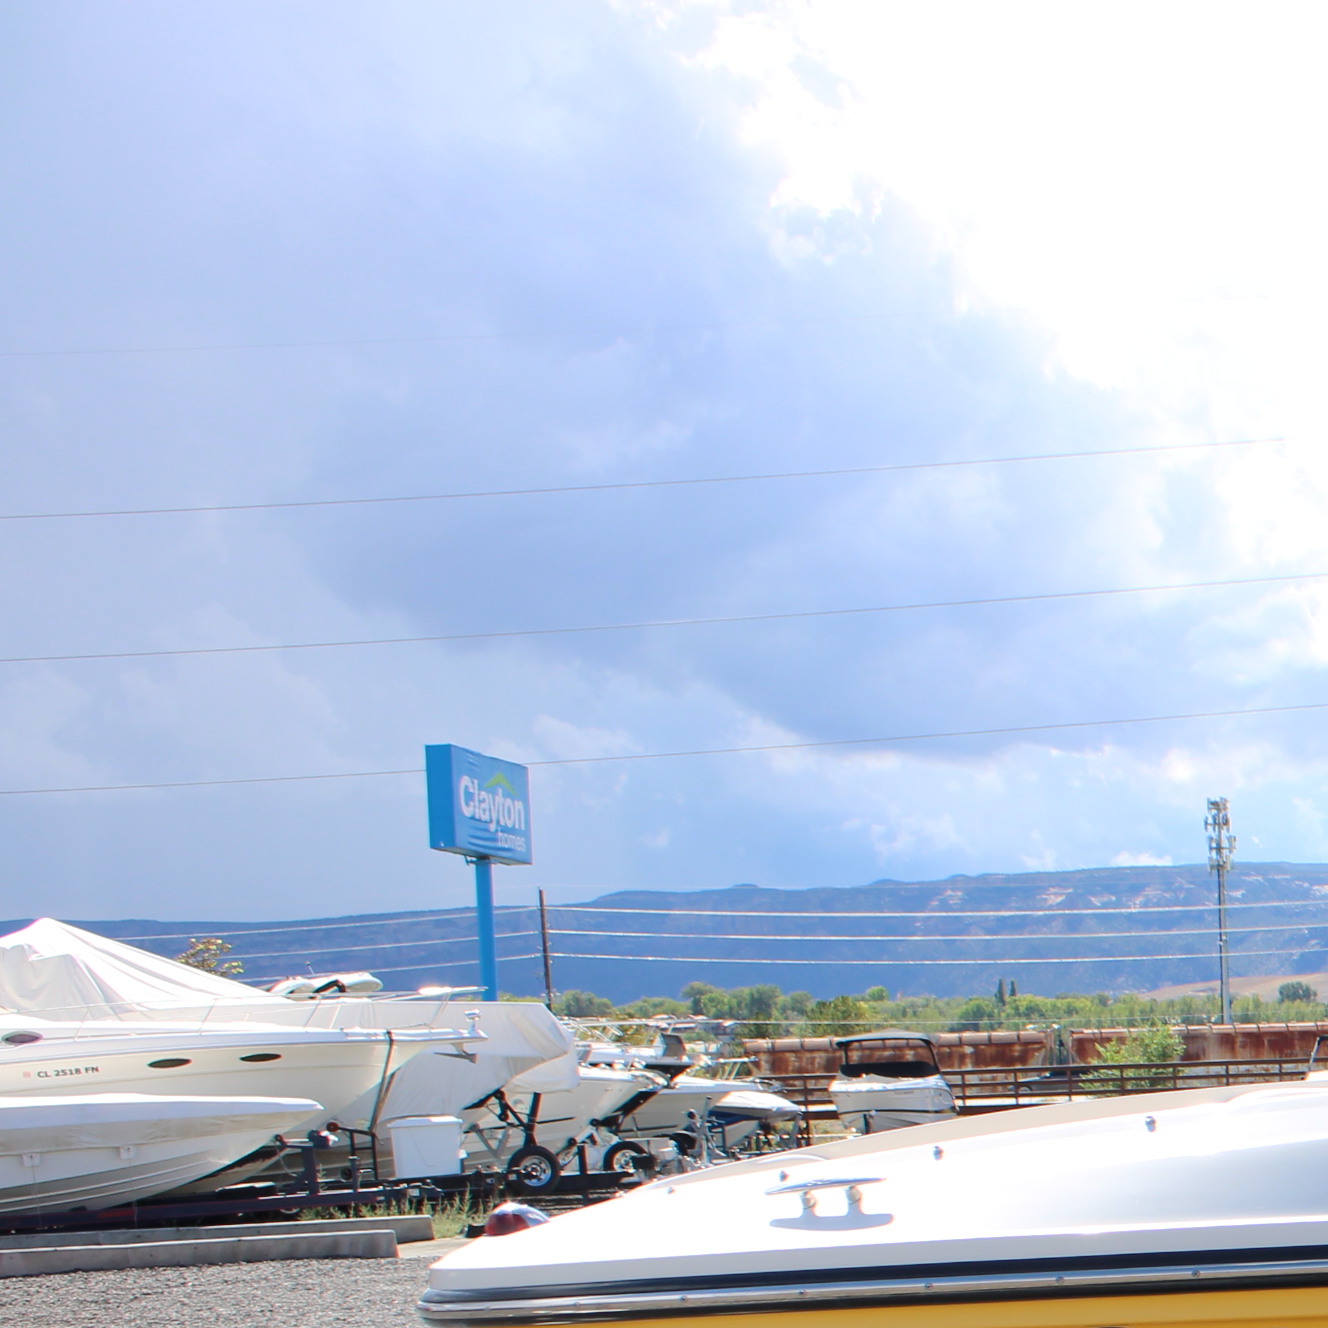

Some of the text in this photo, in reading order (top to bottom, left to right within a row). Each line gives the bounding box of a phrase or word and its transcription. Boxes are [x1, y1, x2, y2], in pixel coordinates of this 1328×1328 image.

[459, 775, 526, 831] Clayton
[497, 828, 526, 851] homes
[37, 1070, 51, 1078] CL
